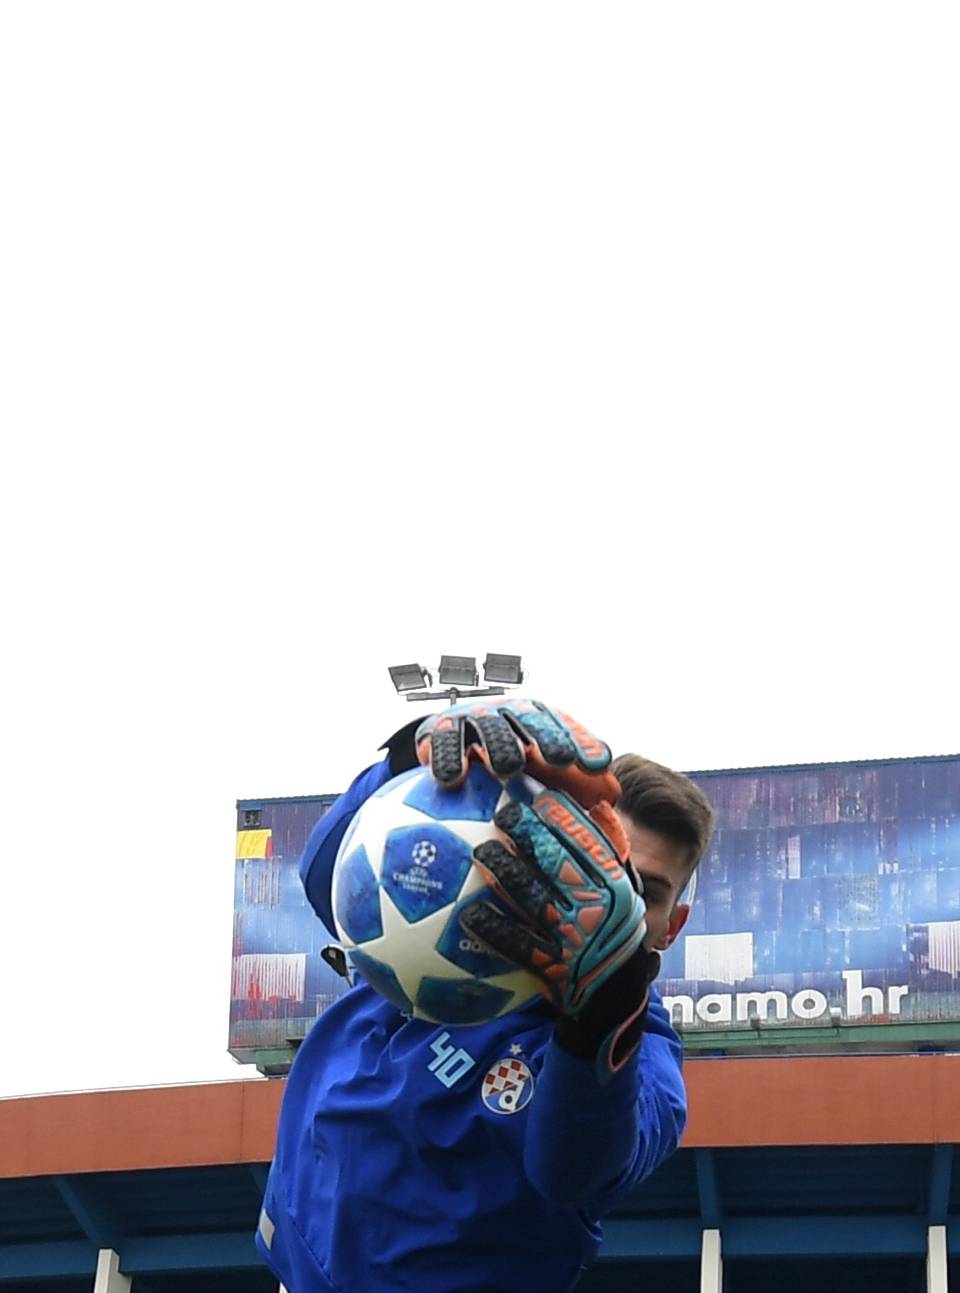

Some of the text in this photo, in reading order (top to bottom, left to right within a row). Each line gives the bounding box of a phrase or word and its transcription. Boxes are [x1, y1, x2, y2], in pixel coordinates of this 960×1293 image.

[392, 871, 443, 890] CHAMPIONS
[662, 970, 908, 1024] namo.hr
[427, 1031, 476, 1089] 40
